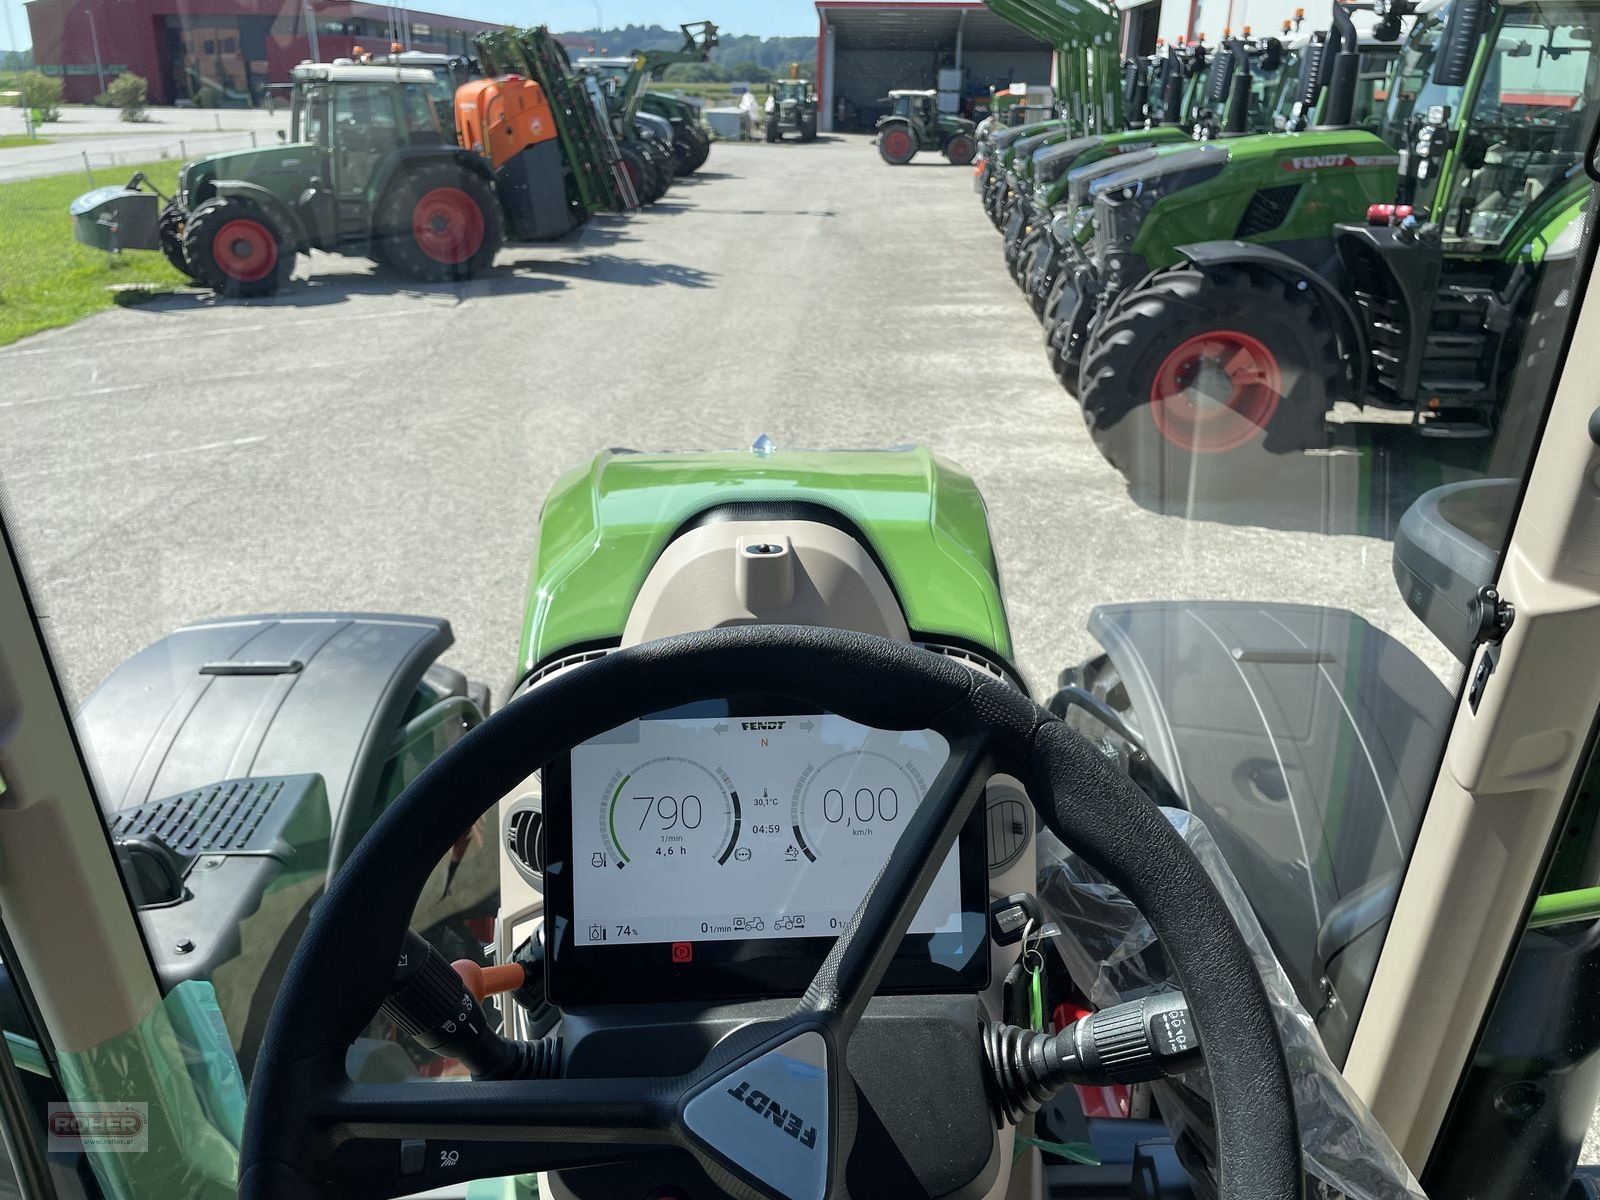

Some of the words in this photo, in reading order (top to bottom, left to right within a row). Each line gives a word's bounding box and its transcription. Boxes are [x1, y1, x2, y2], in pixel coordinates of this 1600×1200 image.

[1292, 154, 1347, 169] FENDT
[741, 721, 785, 730] FENDT
[760, 738, 769, 747] N
[753, 798, 778, 806] 30,1°C
[823, 787, 898, 827] 0,00
[632, 795, 702, 831] 790
[752, 824, 781, 834] 04:59
[852, 828, 873, 837] km/h
[660, 834, 683, 843] 1/min
[655, 846, 674, 856] 4,6
[680, 845, 687, 855] h
[710, 924, 733, 934] 1/min
[726, 1080, 817, 1151] FENDT
